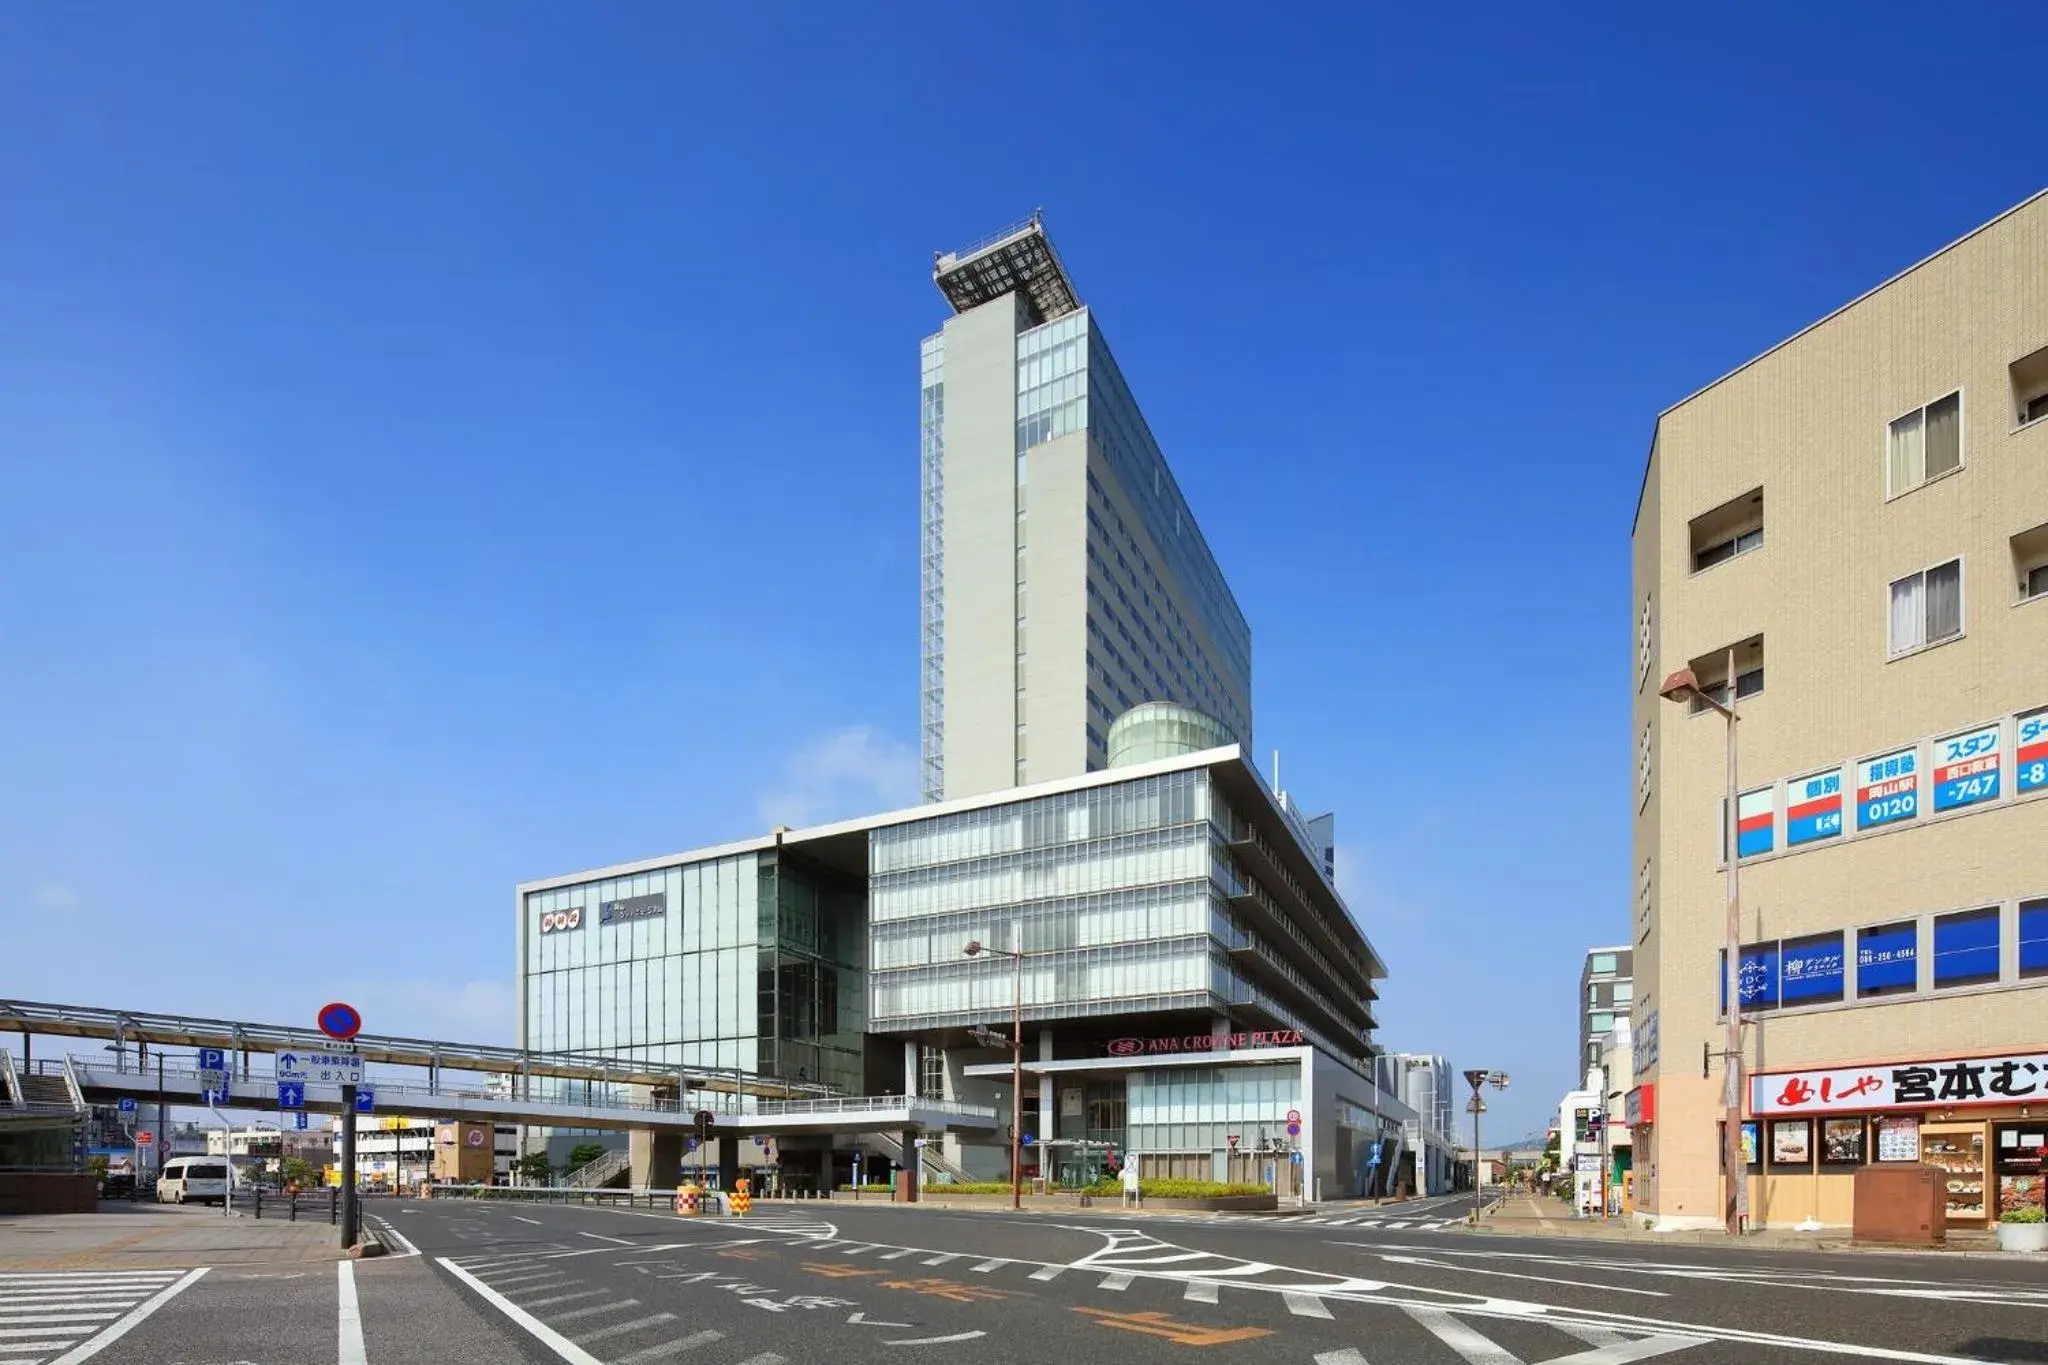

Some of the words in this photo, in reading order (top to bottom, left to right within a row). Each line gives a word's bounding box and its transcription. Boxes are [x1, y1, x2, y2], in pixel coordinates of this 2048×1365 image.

[1806, 772, 1840, 798] 個別
[1869, 754, 1915, 782] 指導塾
[1947, 733, 1997, 761] スタン
[1868, 777, 1914, 800] 岡山駅
[1946, 756, 1998, 780] 西口教室
[1869, 796, 1915, 820] 0120
[1948, 775, 1996, 801] -747
[1785, 958, 1803, 976] 柳
[1149, 1037, 1179, 1051] ANA
[1183, 1032, 1248, 1050] CROWNE
[1252, 1029, 1304, 1045] PLAZA
[206, 1051, 219, 1067] P
[321, 1070, 360, 1082] 出入口
[1777, 1075, 1884, 1106] めしや
[1892, 1061, 2048, 1103] 宮本む
[1588, 1109, 1601, 1122] P
